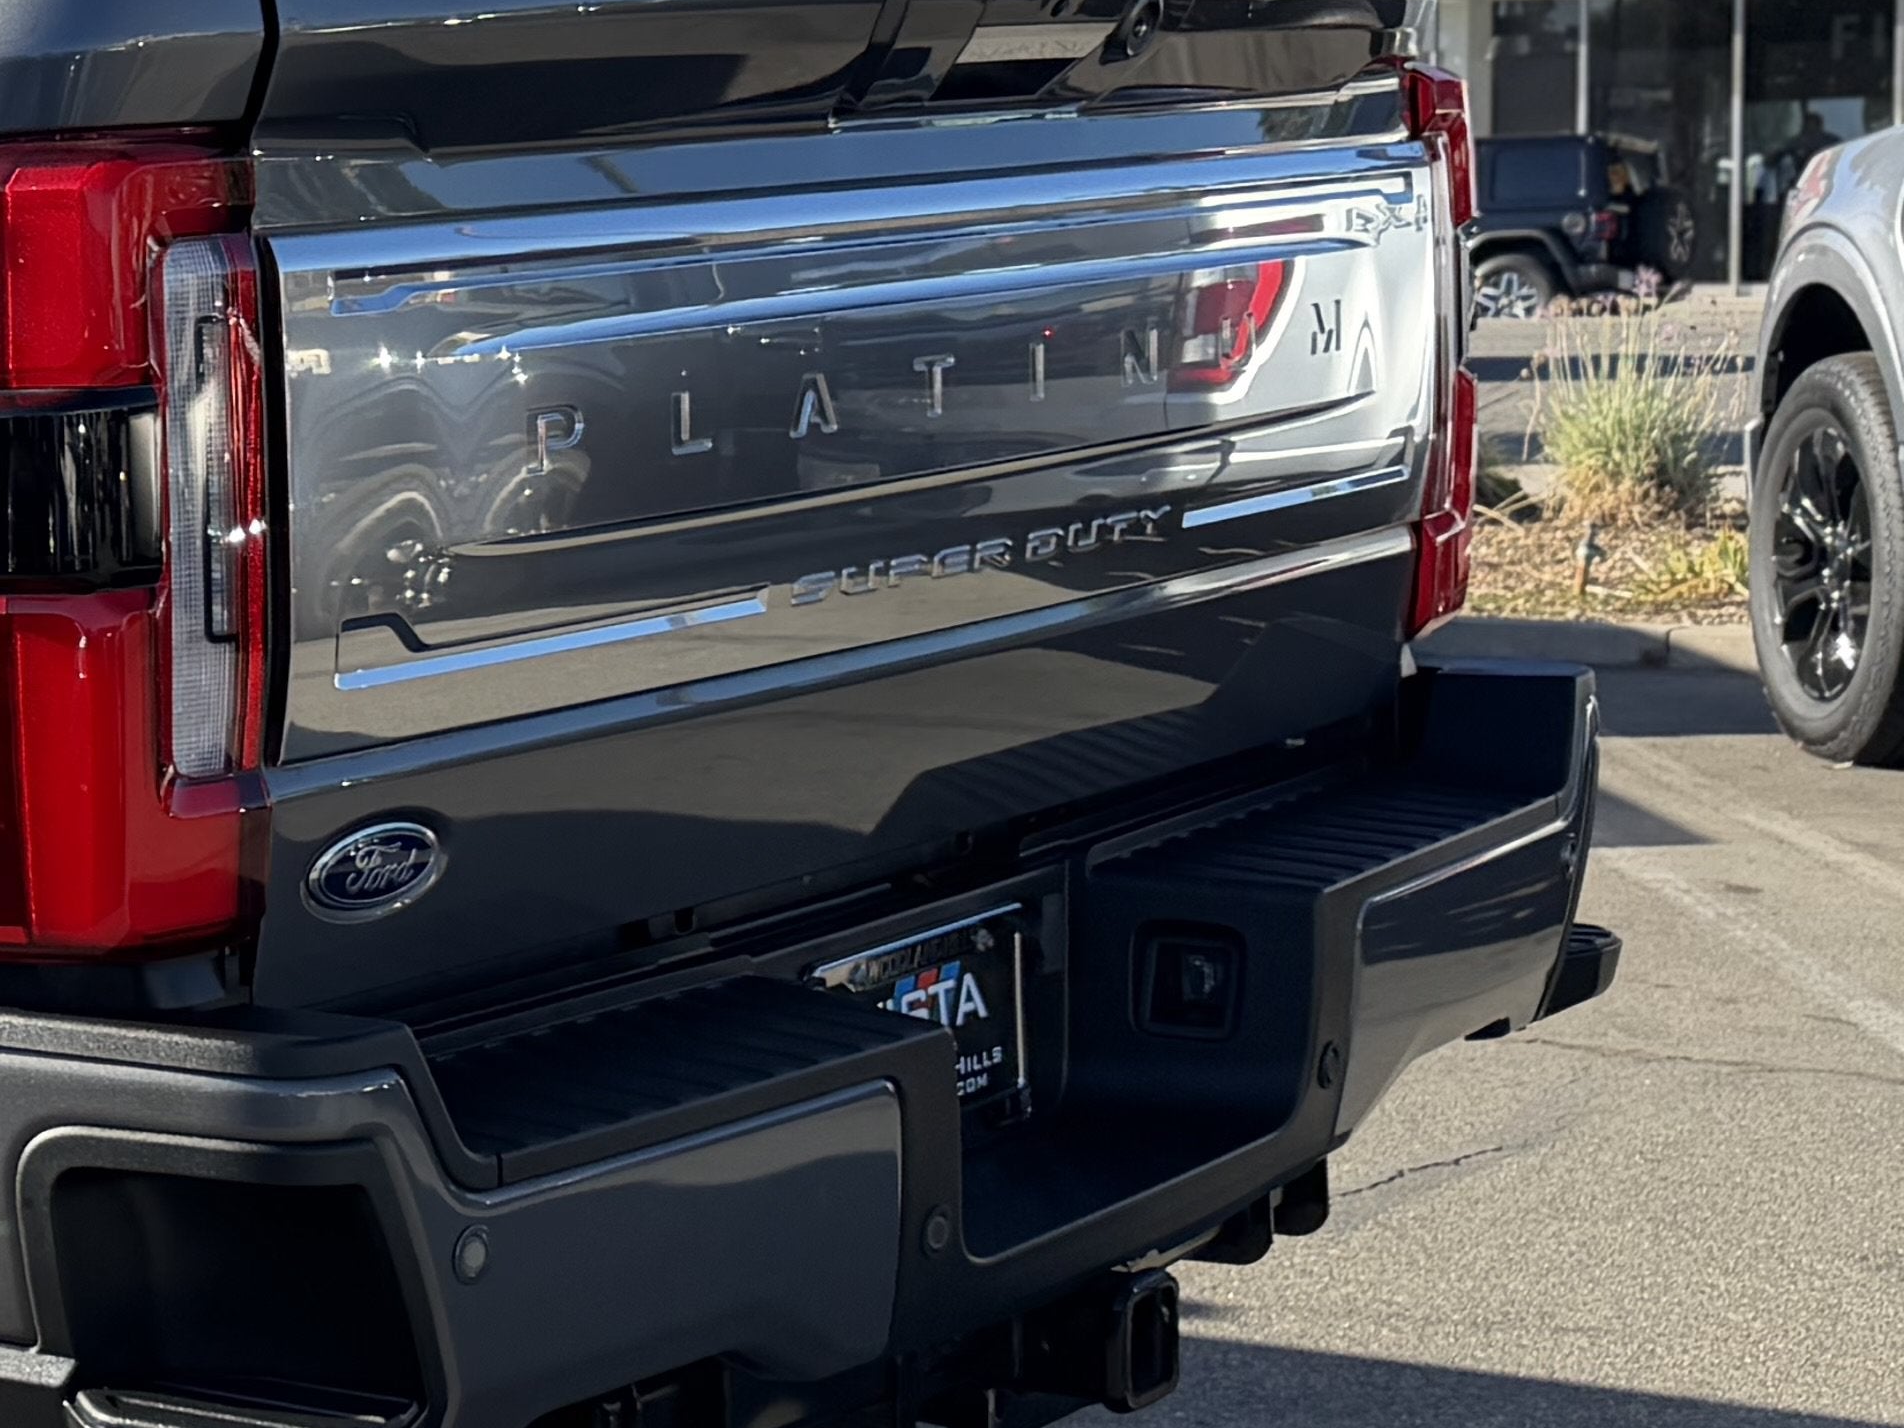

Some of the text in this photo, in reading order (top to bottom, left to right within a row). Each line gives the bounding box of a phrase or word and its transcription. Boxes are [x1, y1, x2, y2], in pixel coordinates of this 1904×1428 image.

[526, 298, 1343, 477] PLATINUM
[791, 505, 1172, 606] SUPER DUTY
[345, 841, 417, 894] Ford
